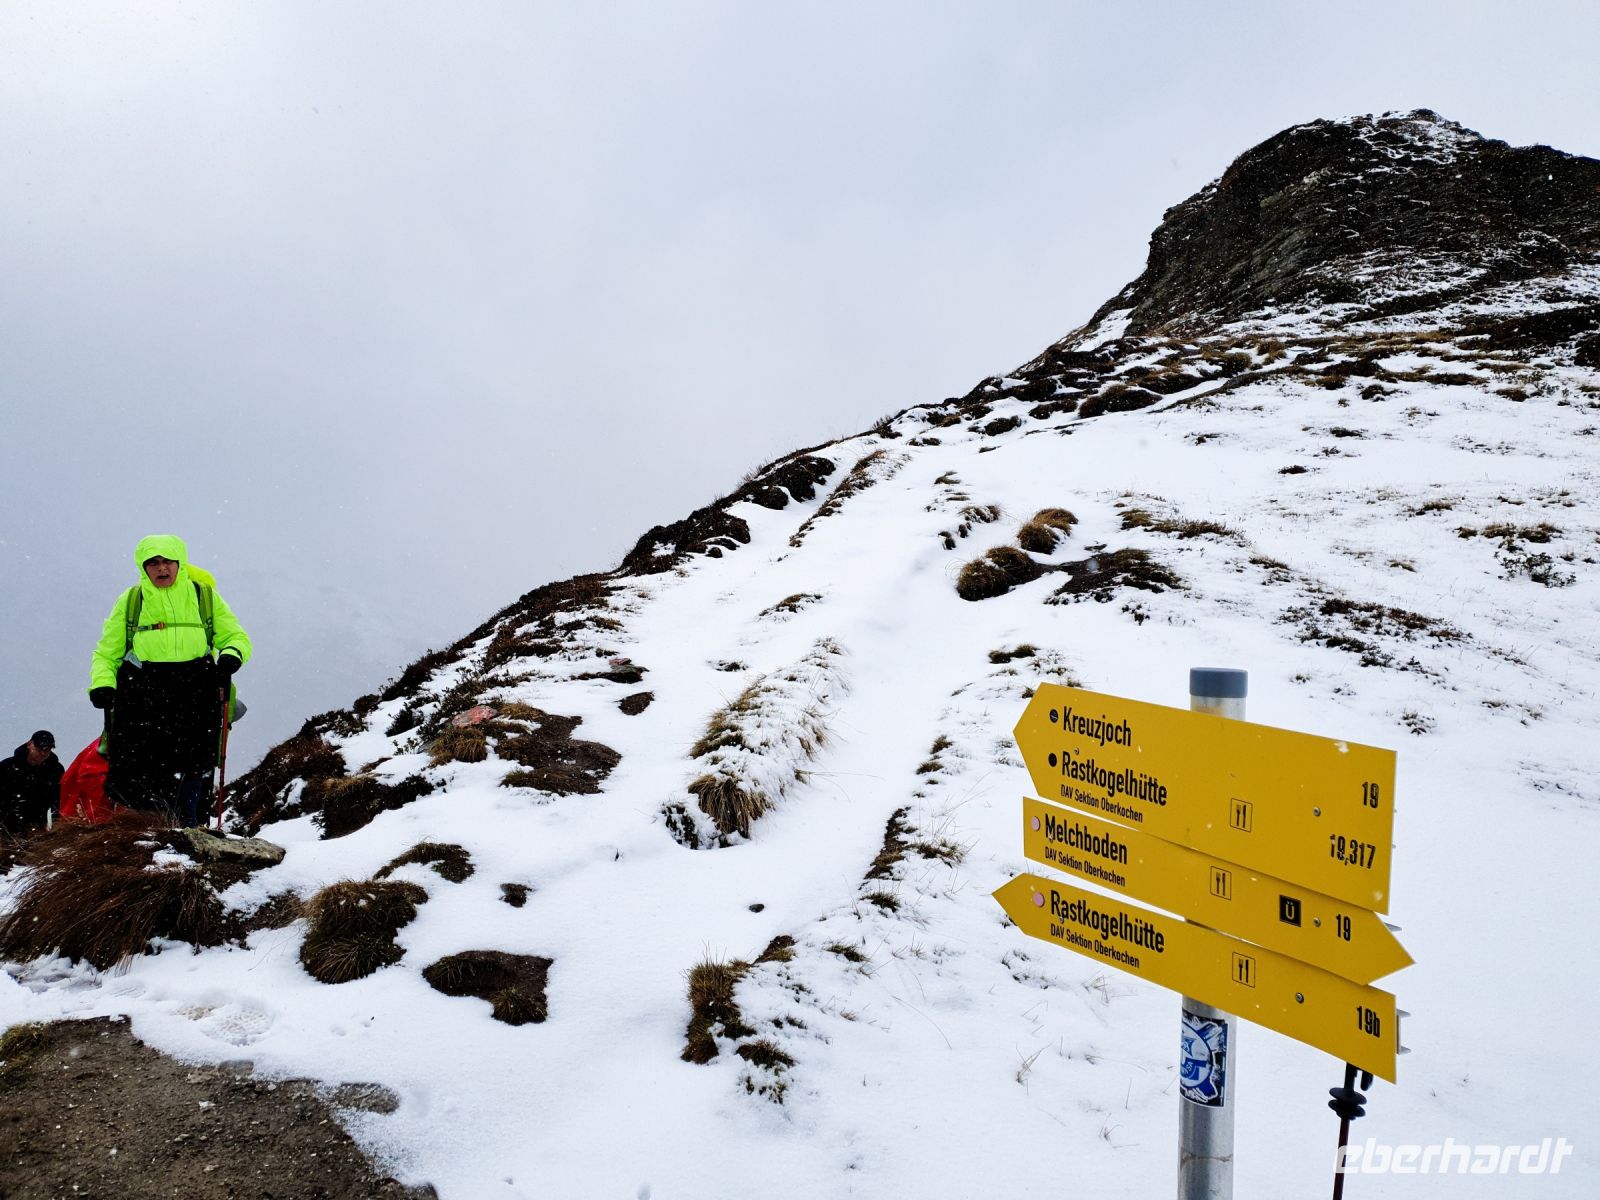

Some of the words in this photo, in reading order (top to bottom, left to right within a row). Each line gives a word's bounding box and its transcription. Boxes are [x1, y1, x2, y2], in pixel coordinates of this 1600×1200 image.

[1063, 706, 1131, 747] Kreuzjoch
[1061, 751, 1167, 806] Rastkogelhütte
[1361, 781, 1380, 809] 19
[1060, 784, 1074, 799] DAV
[1074, 789, 1099, 809] Sektion
[1101, 797, 1143, 823] Oberkochen
[1045, 813, 1128, 865] Melchboden
[1045, 847, 1057, 861] DAV
[1058, 852, 1083, 871] Sektion
[1084, 864, 1126, 887] Oberkochen
[1050, 889, 1165, 953] Rastkogelhütte
[1335, 913, 1351, 942] 19
[1050, 923, 1065, 939] DAV
[1066, 929, 1092, 950] Sektion
[1094, 939, 1140, 968] Oberkochen
[1356, 1005, 1381, 1038] 19b
